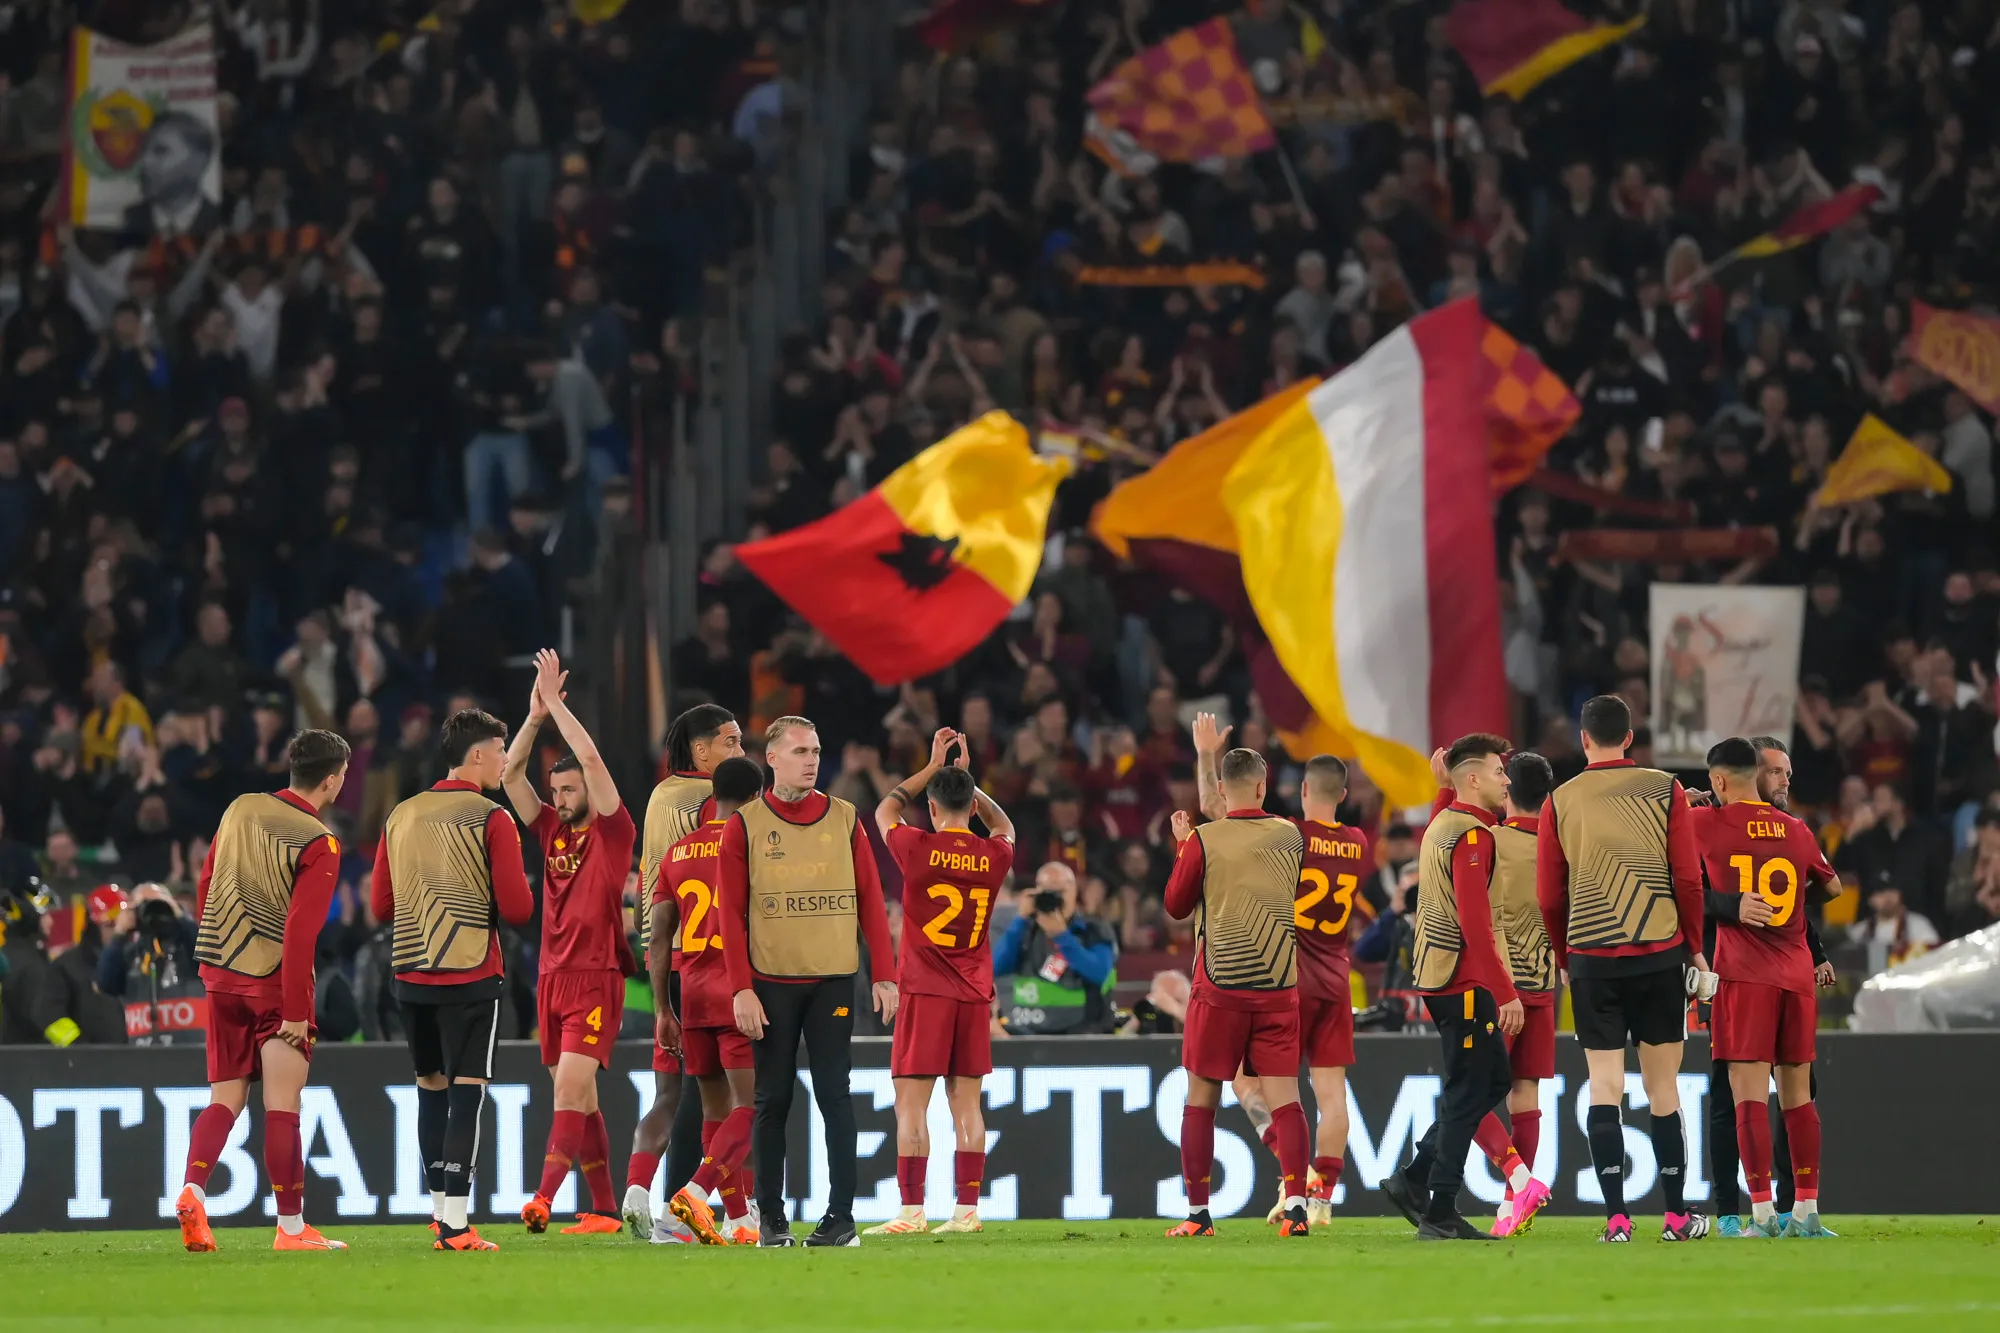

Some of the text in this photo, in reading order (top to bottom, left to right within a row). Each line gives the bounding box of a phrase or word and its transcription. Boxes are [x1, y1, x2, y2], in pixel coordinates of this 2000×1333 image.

[1309, 836, 1361, 859] MANCINI
[929, 850, 989, 872] DYBALA
[1294, 868, 1358, 935] 23
[1730, 855, 1797, 926] 19
[786, 895, 857, 912] RESPECT
[922, 883, 990, 948] 21
[586, 1006, 602, 1031] 4
